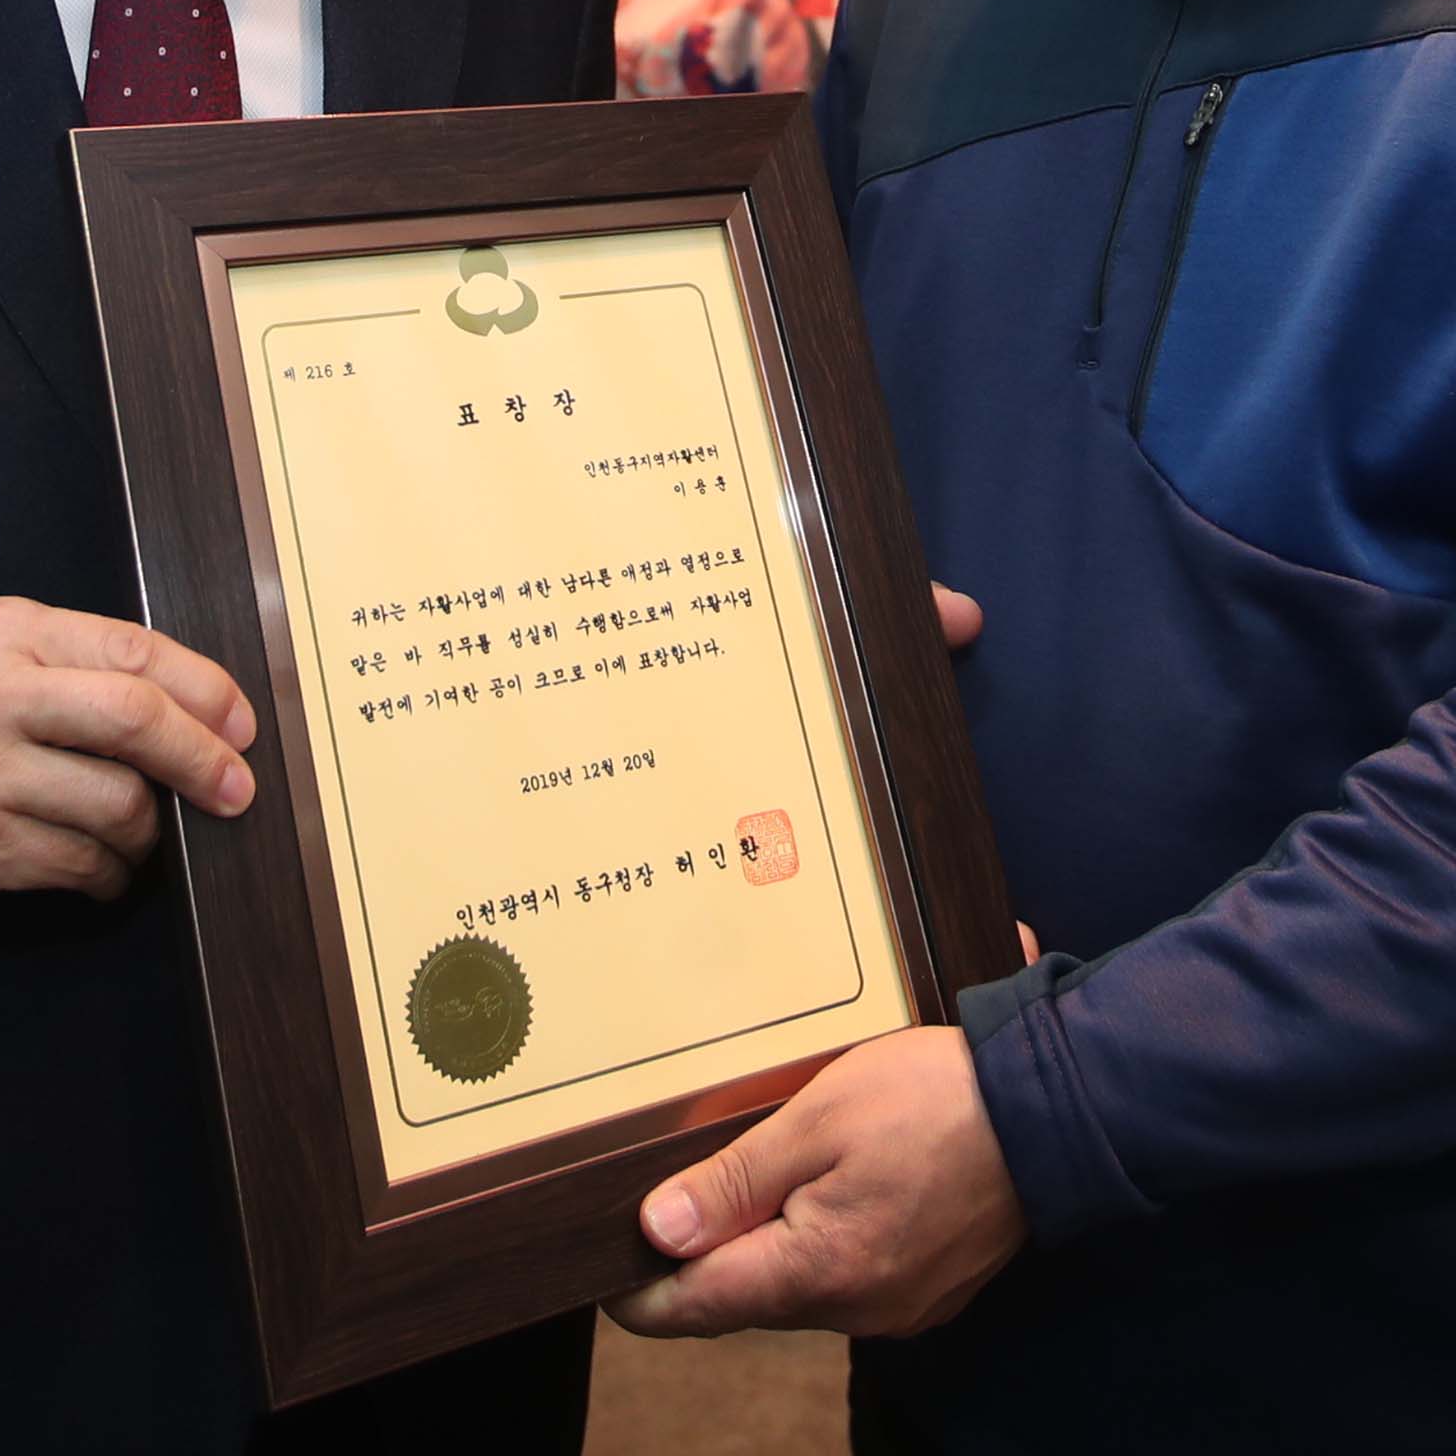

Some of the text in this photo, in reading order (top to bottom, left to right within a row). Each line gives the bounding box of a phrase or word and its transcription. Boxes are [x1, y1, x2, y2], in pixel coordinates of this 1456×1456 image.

[305, 363, 333, 380] 216
[342, 361, 356, 377] 호
[351, 547, 745, 628] 귀하는 자활사업에 대한 남다른 애정과 열정으로
[403, 645, 423, 666] 바
[438, 633, 492, 660] 직무를
[508, 621, 558, 649] 성실히
[575, 600, 674, 637] 수행함으로써
[690, 587, 753, 615] 자활사업
[358, 637, 726, 724] 발전에 기여한 공이 크므로 이에 표창합니다.
[520, 748, 656, 794] 2019년 12월 20일
[455, 884, 560, 931] 인천광역시
[573, 862, 655, 903] 동구청장
